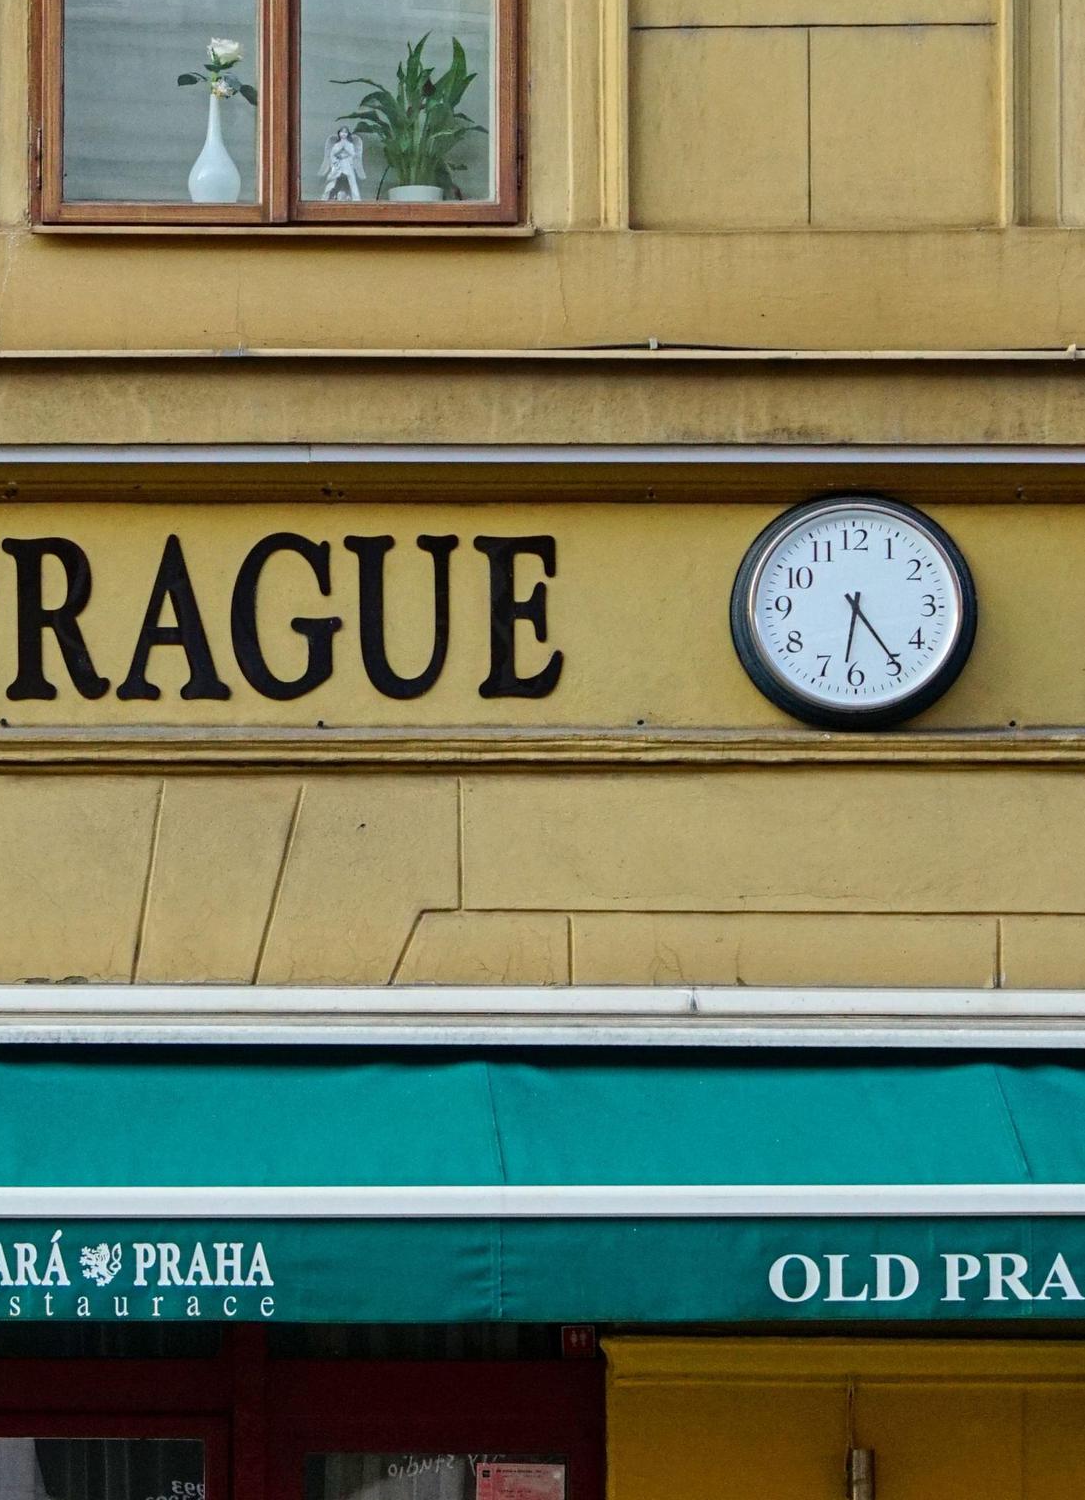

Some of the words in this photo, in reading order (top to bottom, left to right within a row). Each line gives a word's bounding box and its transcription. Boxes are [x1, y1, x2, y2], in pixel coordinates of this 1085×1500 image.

[811, 540, 835, 563] 11
[840, 529, 868, 551] 12
[884, 538, 896, 560] 1
[787, 566, 813, 589] 10
[906, 559, 922, 581] 2
[775, 596, 792, 620] 9
[920, 594, 936, 617] 3
[786, 630, 803, 653] 8
[908, 627, 925, 650] 4
[817, 655, 832, 677] 7
[847, 661, 865, 686] 6
[886, 653, 902, 677] 5
[132, 1242, 274, 1287] PRAHA
[768, 1253, 919, 1303] OLD
[940, 1252, 1085, 1301] PRA
